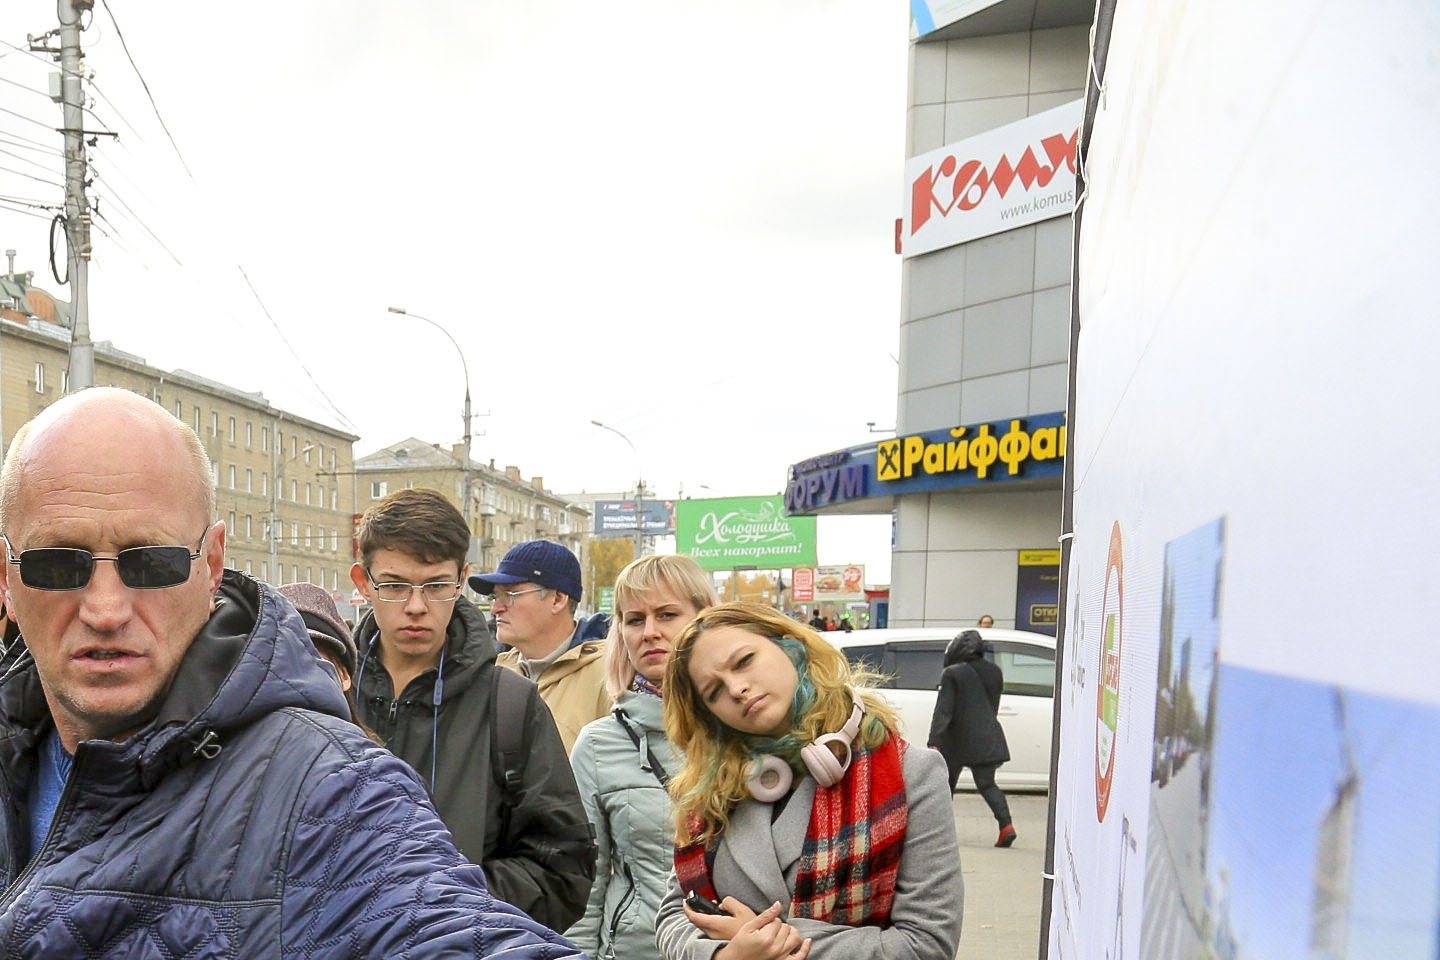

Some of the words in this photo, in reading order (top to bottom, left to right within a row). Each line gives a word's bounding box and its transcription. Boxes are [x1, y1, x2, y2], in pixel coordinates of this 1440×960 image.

[695, 511, 794, 544] Холодушка
[691, 547, 721, 558] Всех
[724, 542, 803, 557] накормит!
